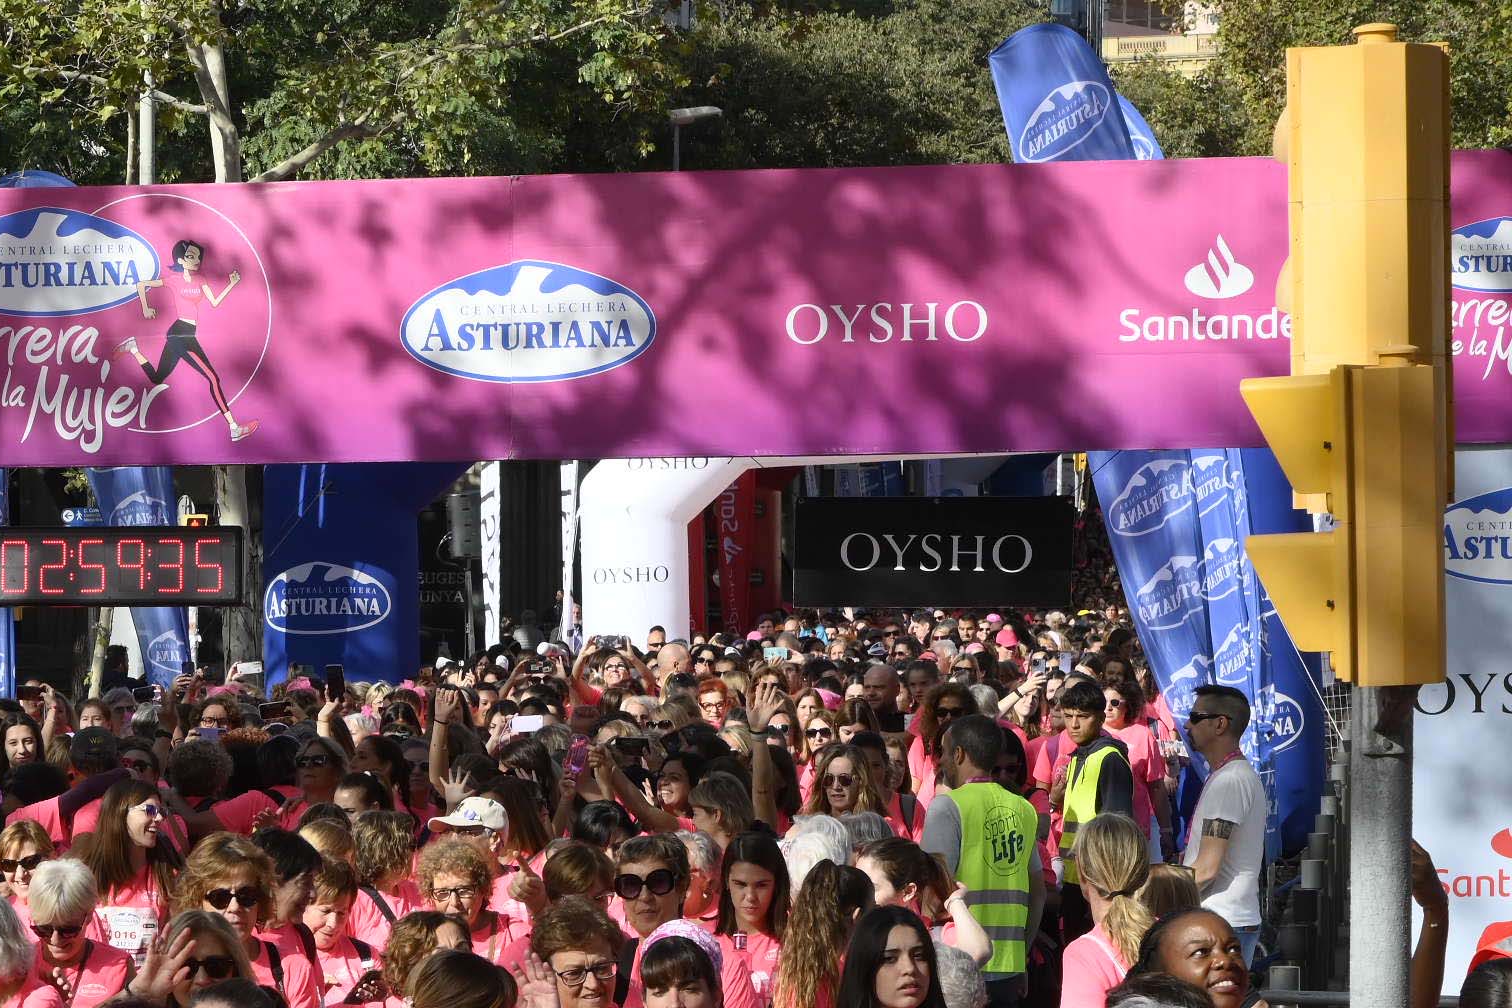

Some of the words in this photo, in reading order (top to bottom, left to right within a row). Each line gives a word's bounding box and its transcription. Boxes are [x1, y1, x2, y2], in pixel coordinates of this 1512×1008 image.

[63, 244, 134, 255] LECHERA
[1451, 253, 1512, 274] STUR
[460, 303, 539, 316] CENTRAL
[546, 301, 628, 315] LECHERA
[785, 301, 988, 345] OYSHO
[1118, 307, 1292, 343] Santande
[421, 307, 637, 353] ASTURIANA
[1482, 325, 1512, 381] M
[1, 368, 26, 408] la
[20, 357, 170, 454] Mujer
[1467, 521, 1512, 531] CENT
[0, 539, 223, 594] 02:59:35
[839, 531, 1033, 574] OYSHO
[593, 565, 669, 585] OYSHO
[269, 592, 382, 619] ASTURIANA
[984, 811, 1017, 841] Sport
[992, 830, 1024, 864] Life
